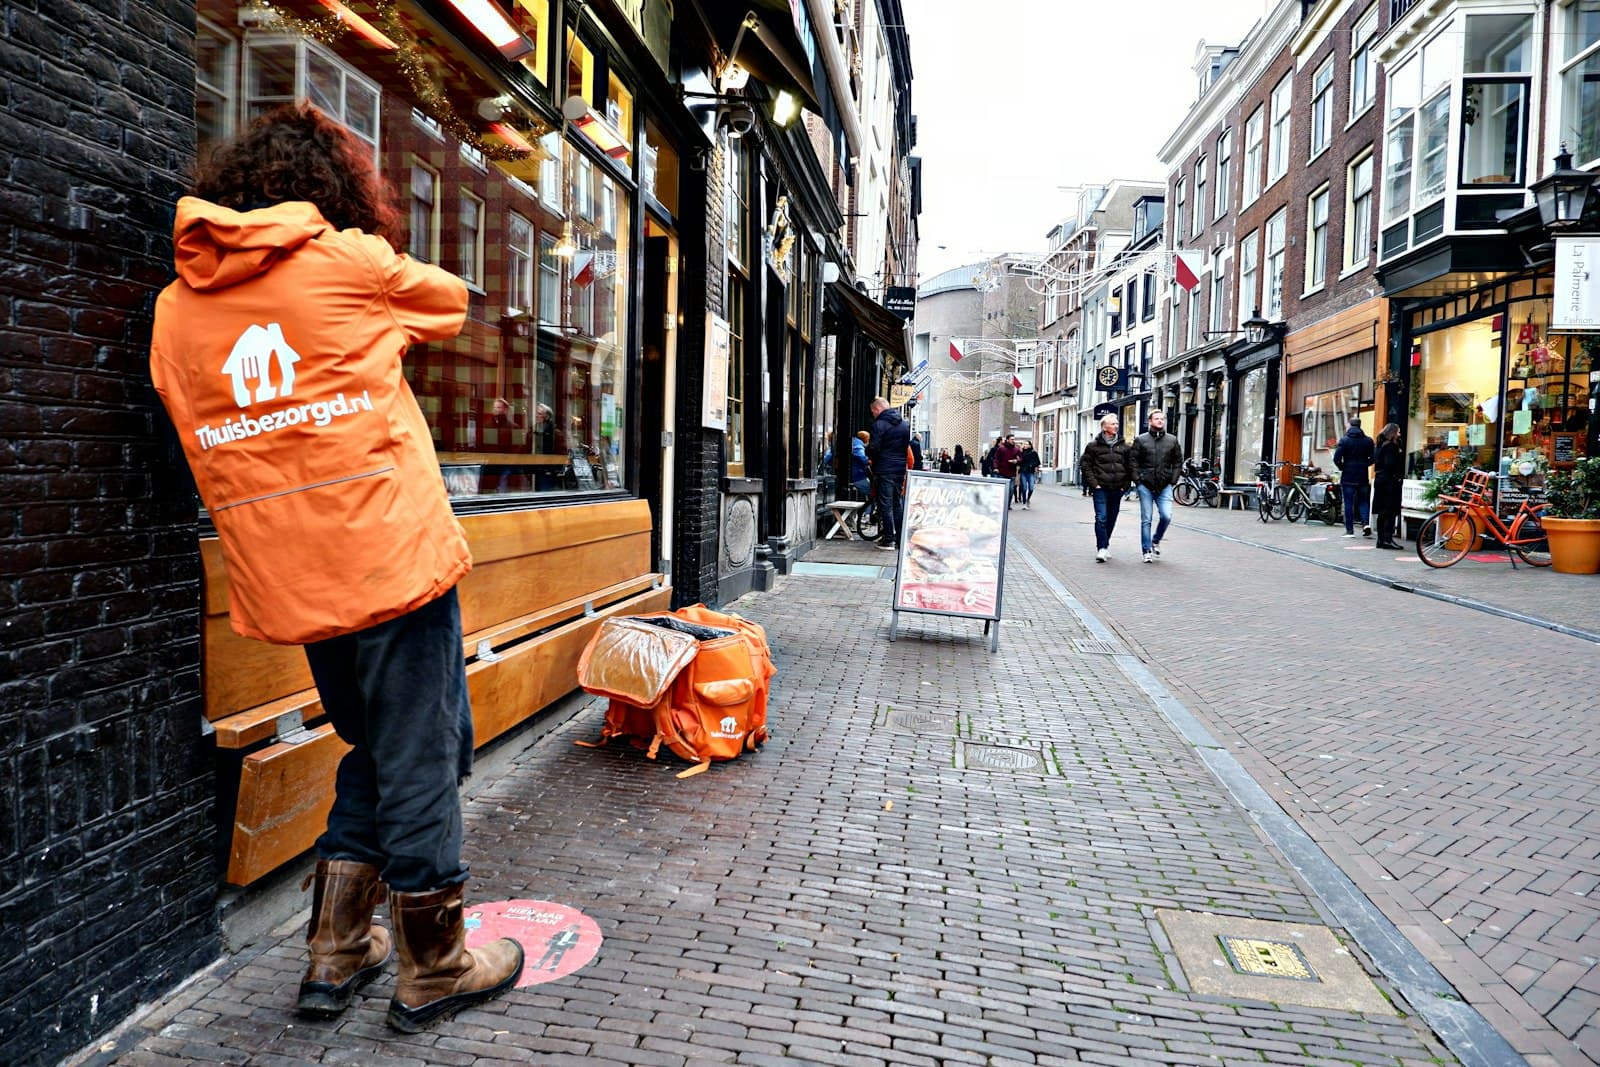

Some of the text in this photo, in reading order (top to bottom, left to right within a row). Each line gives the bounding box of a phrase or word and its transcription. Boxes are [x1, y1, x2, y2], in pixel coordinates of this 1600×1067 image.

[1570, 244, 1586, 312] La Palmerie
[195, 390, 374, 450] Thuisbezorgd.nl
[911, 486, 965, 505] LUNCH
